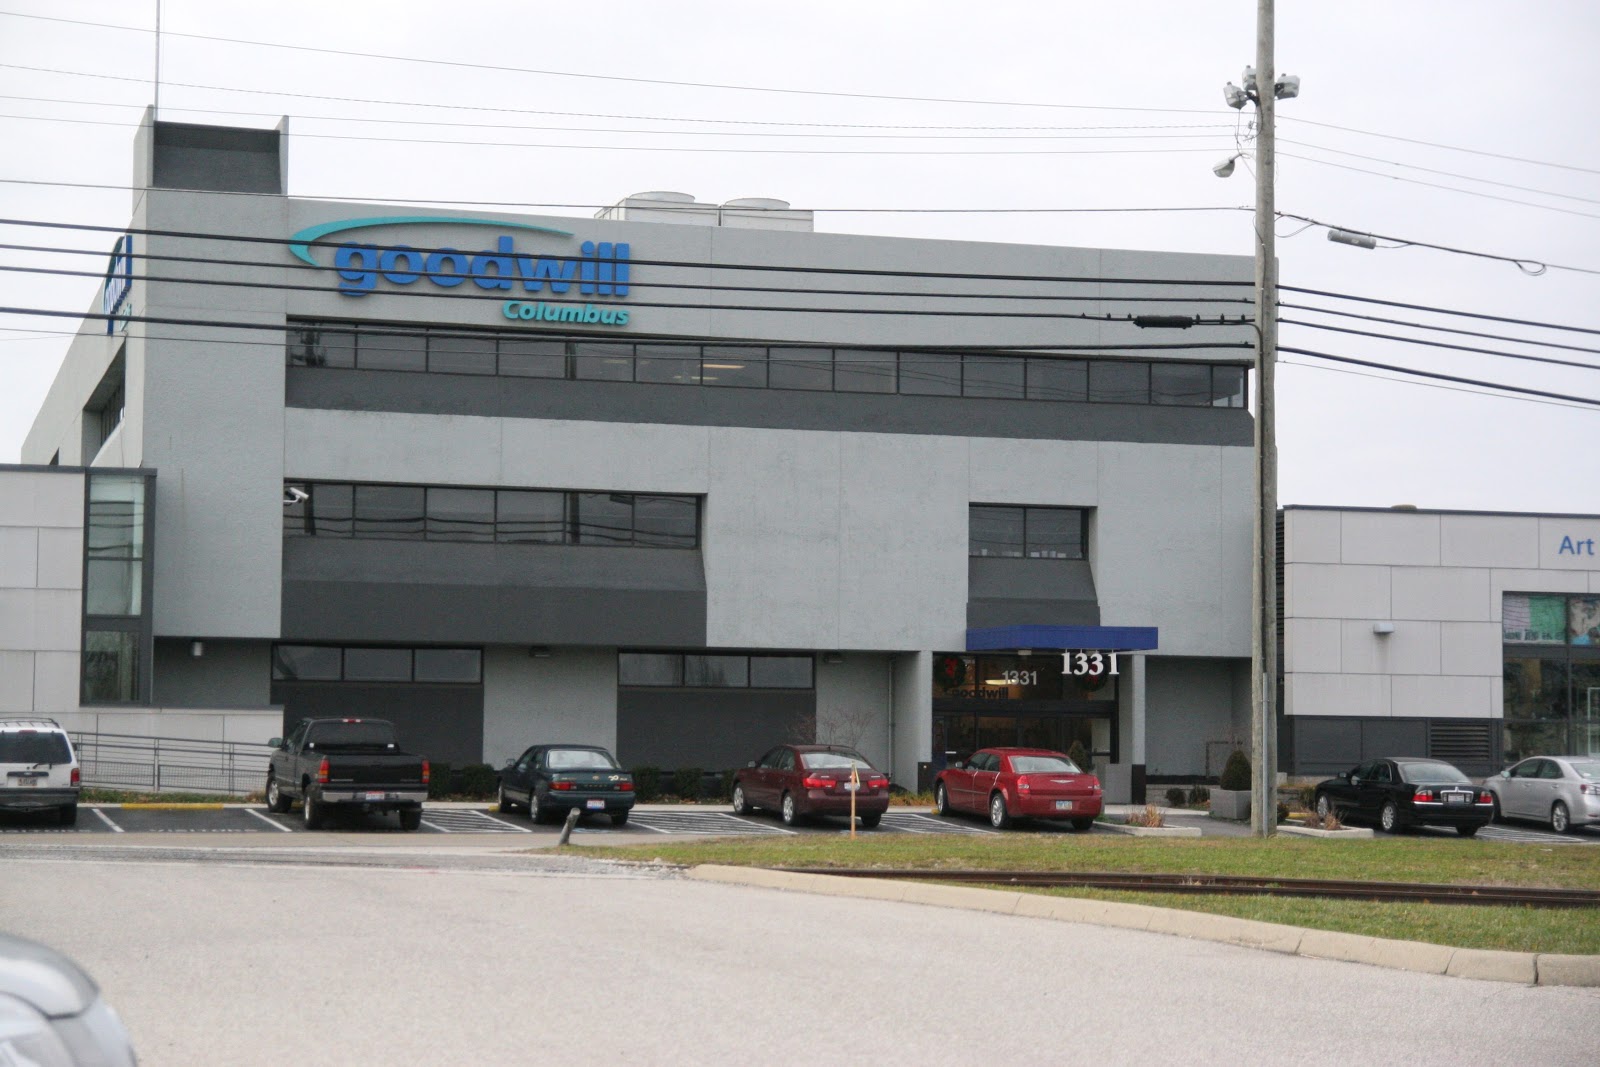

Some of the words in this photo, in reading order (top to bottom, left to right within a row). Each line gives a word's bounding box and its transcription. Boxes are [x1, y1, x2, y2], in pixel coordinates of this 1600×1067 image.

[335, 236, 630, 297] goodwill
[503, 300, 630, 326] Columbus
[1558, 535, 1595, 556] Art
[1061, 652, 1120, 675] 1331
[1002, 670, 1037, 686] 1331
